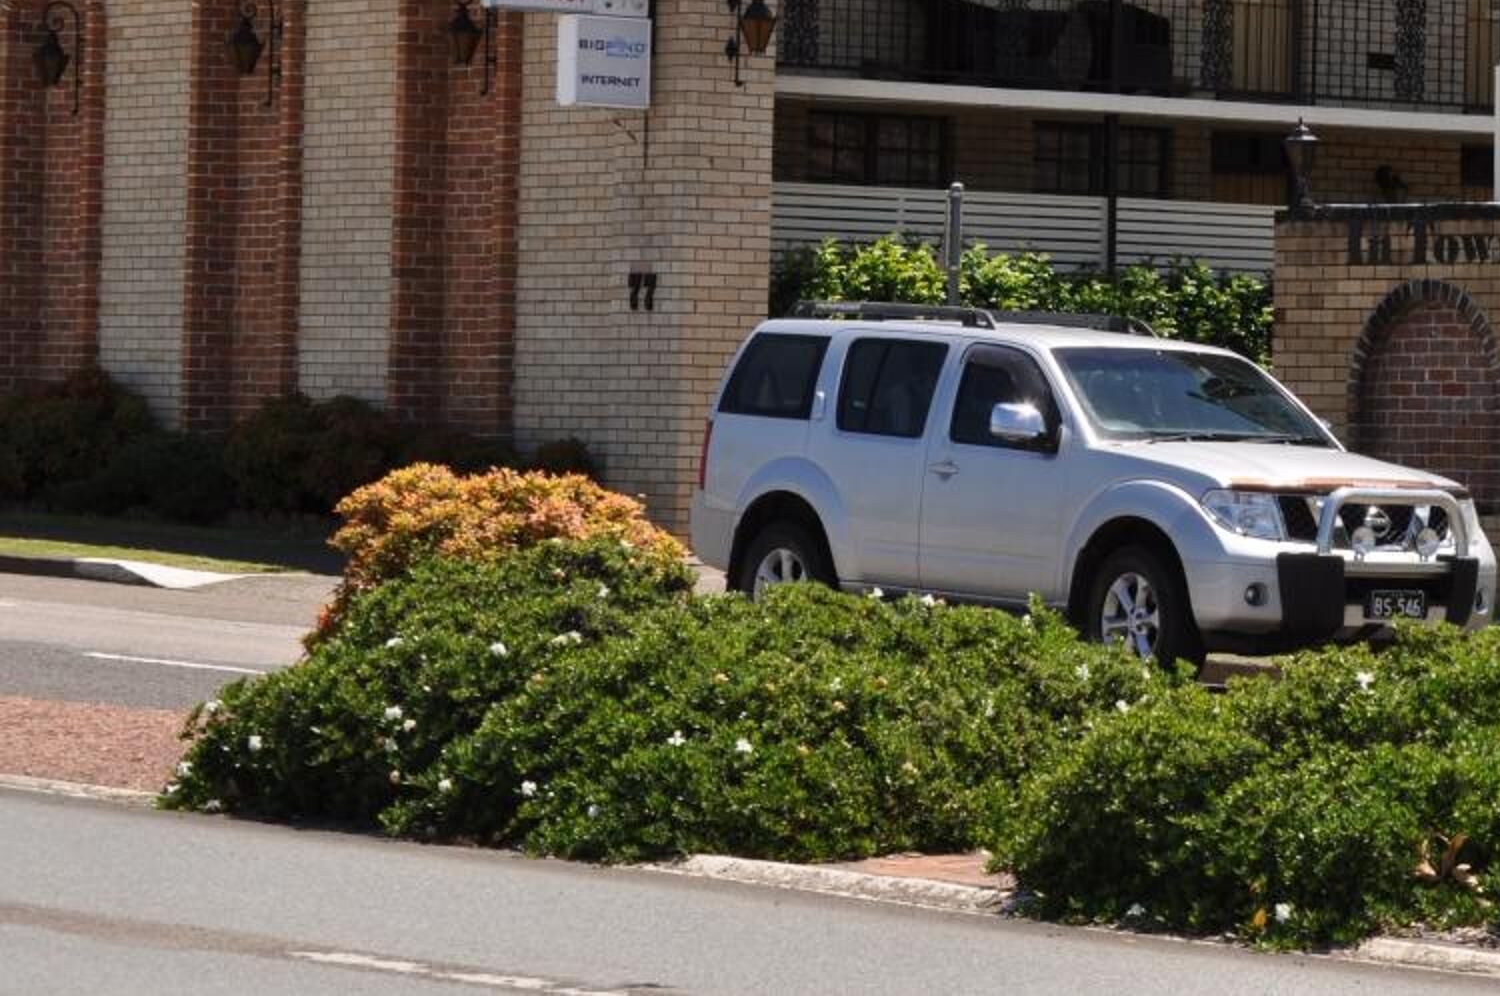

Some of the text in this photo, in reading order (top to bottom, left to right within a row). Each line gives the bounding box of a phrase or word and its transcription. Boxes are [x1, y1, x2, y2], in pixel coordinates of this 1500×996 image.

[581, 75, 641, 88] INTERNET
[1347, 219, 1391, 265] In
[628, 273, 656, 311] 77
